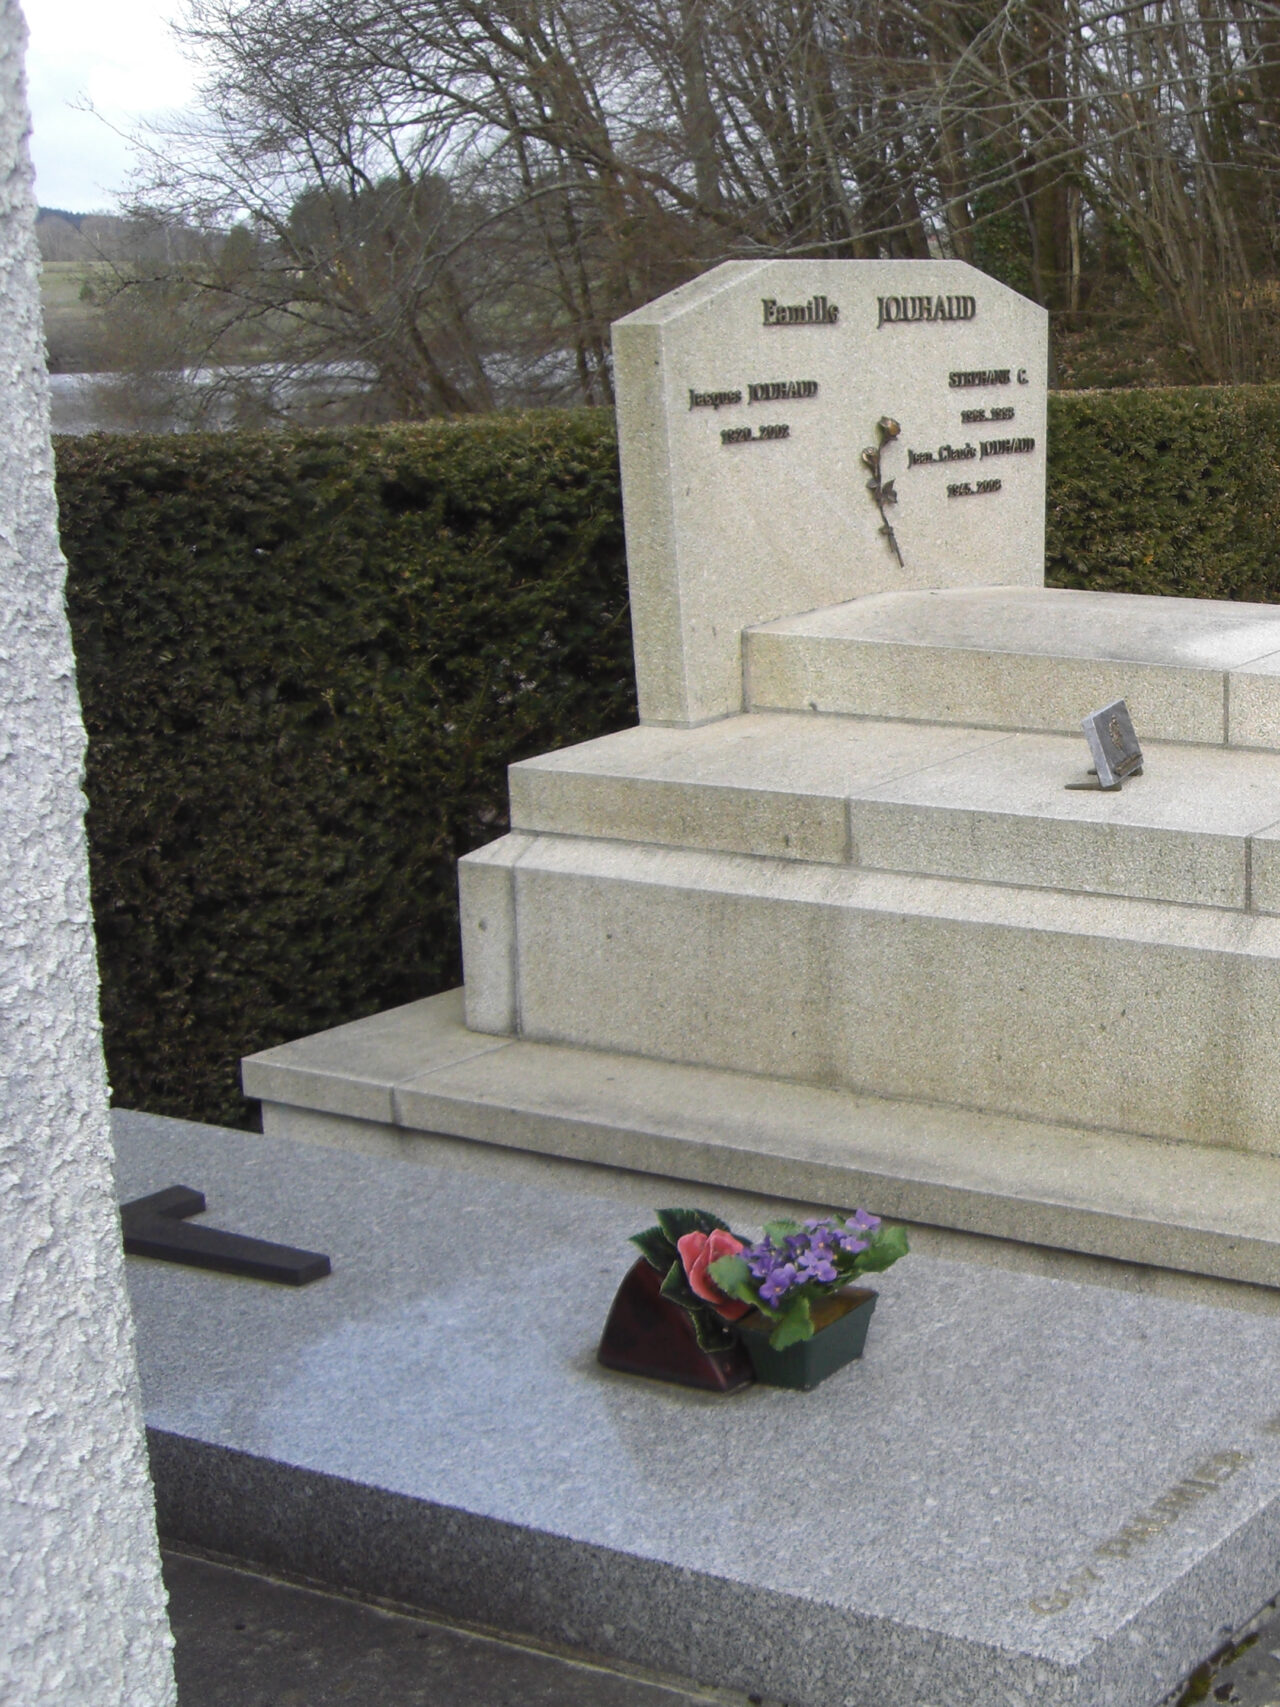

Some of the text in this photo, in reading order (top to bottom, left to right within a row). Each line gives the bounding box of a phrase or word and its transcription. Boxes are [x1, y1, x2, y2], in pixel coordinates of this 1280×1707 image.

[762, 295, 977, 329] Famille JOUHAUD
[689, 381, 818, 411] Jacques JOUHAUD
[980, 438, 1035, 460] JOUHAUD
